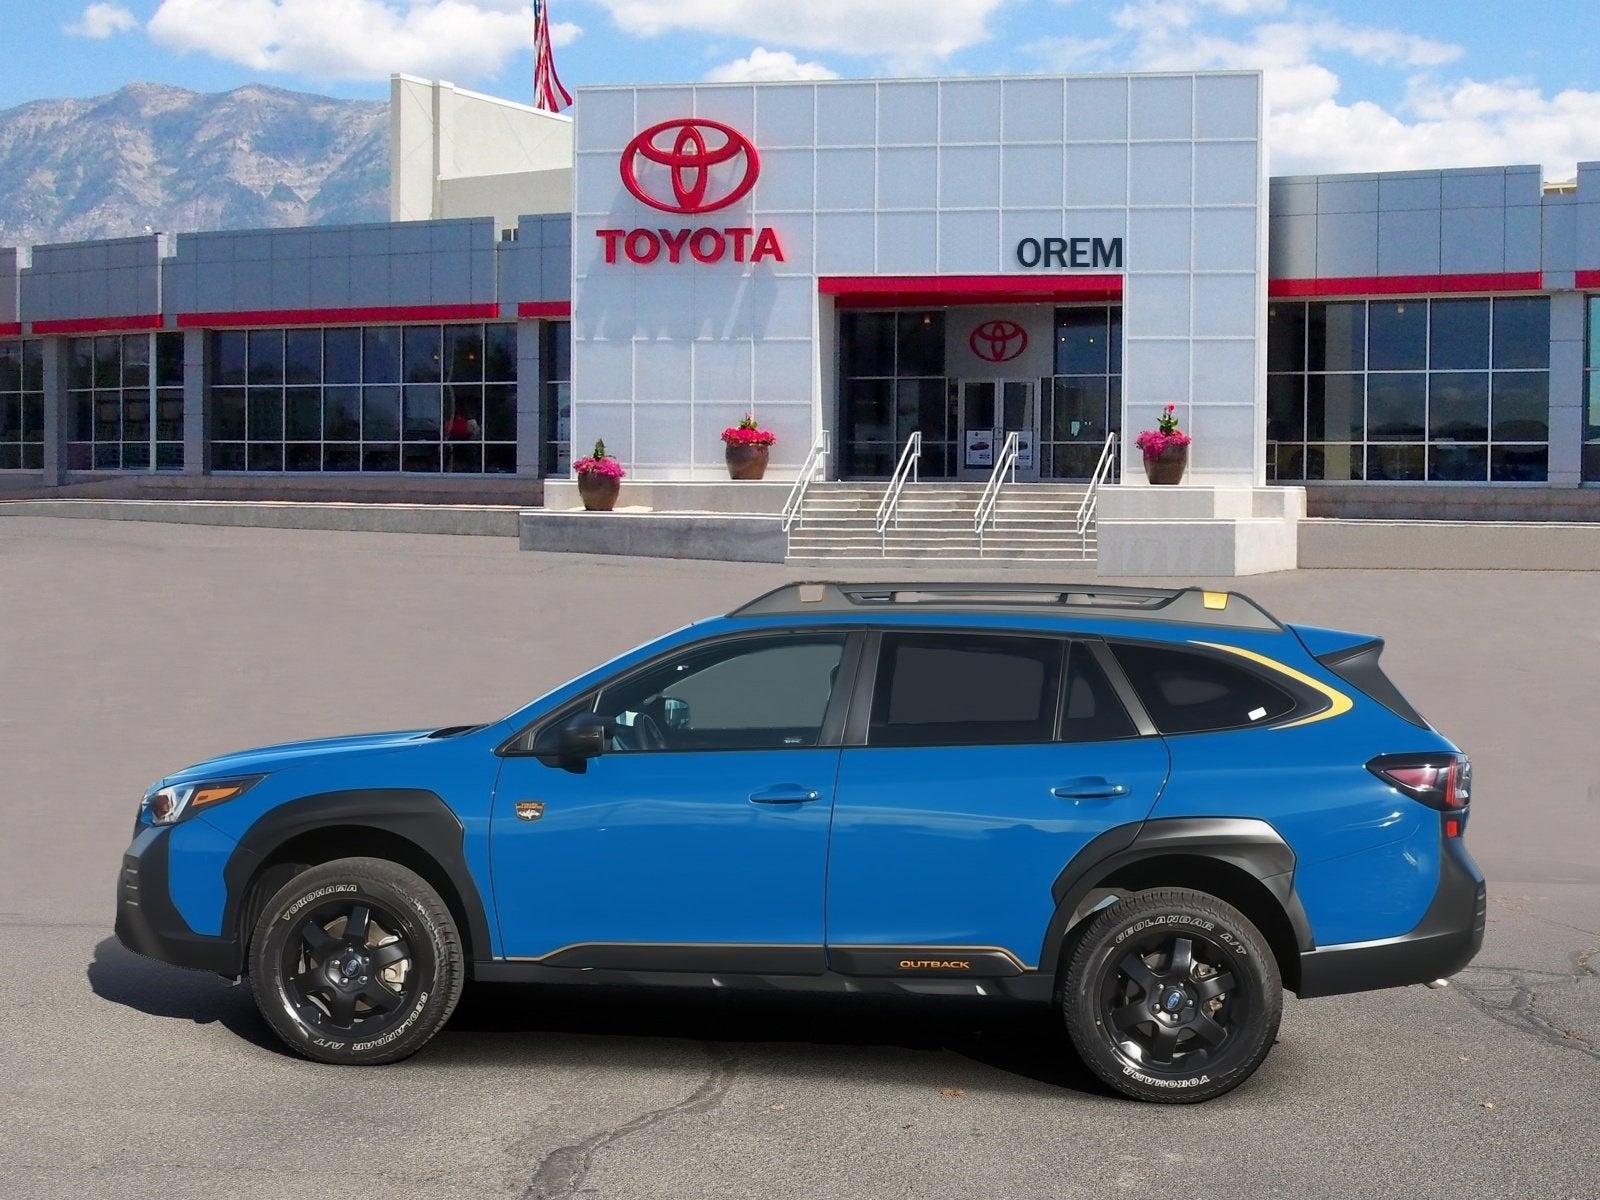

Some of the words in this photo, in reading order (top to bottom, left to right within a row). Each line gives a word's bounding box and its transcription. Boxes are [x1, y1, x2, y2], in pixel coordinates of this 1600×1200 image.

[596, 227, 784, 264] TOYOTA
[1016, 237, 1123, 268] OREM
[282, 884, 358, 921] YOKOHAMA
[1115, 915, 1215, 944] GEOLANDAR
[1219, 933, 1247, 955] A/T
[900, 960, 970, 969] OUTBACK
[352, 991, 429, 1051] GEOLANDAR
[1122, 1066, 1210, 1088] YOKOHAMA
